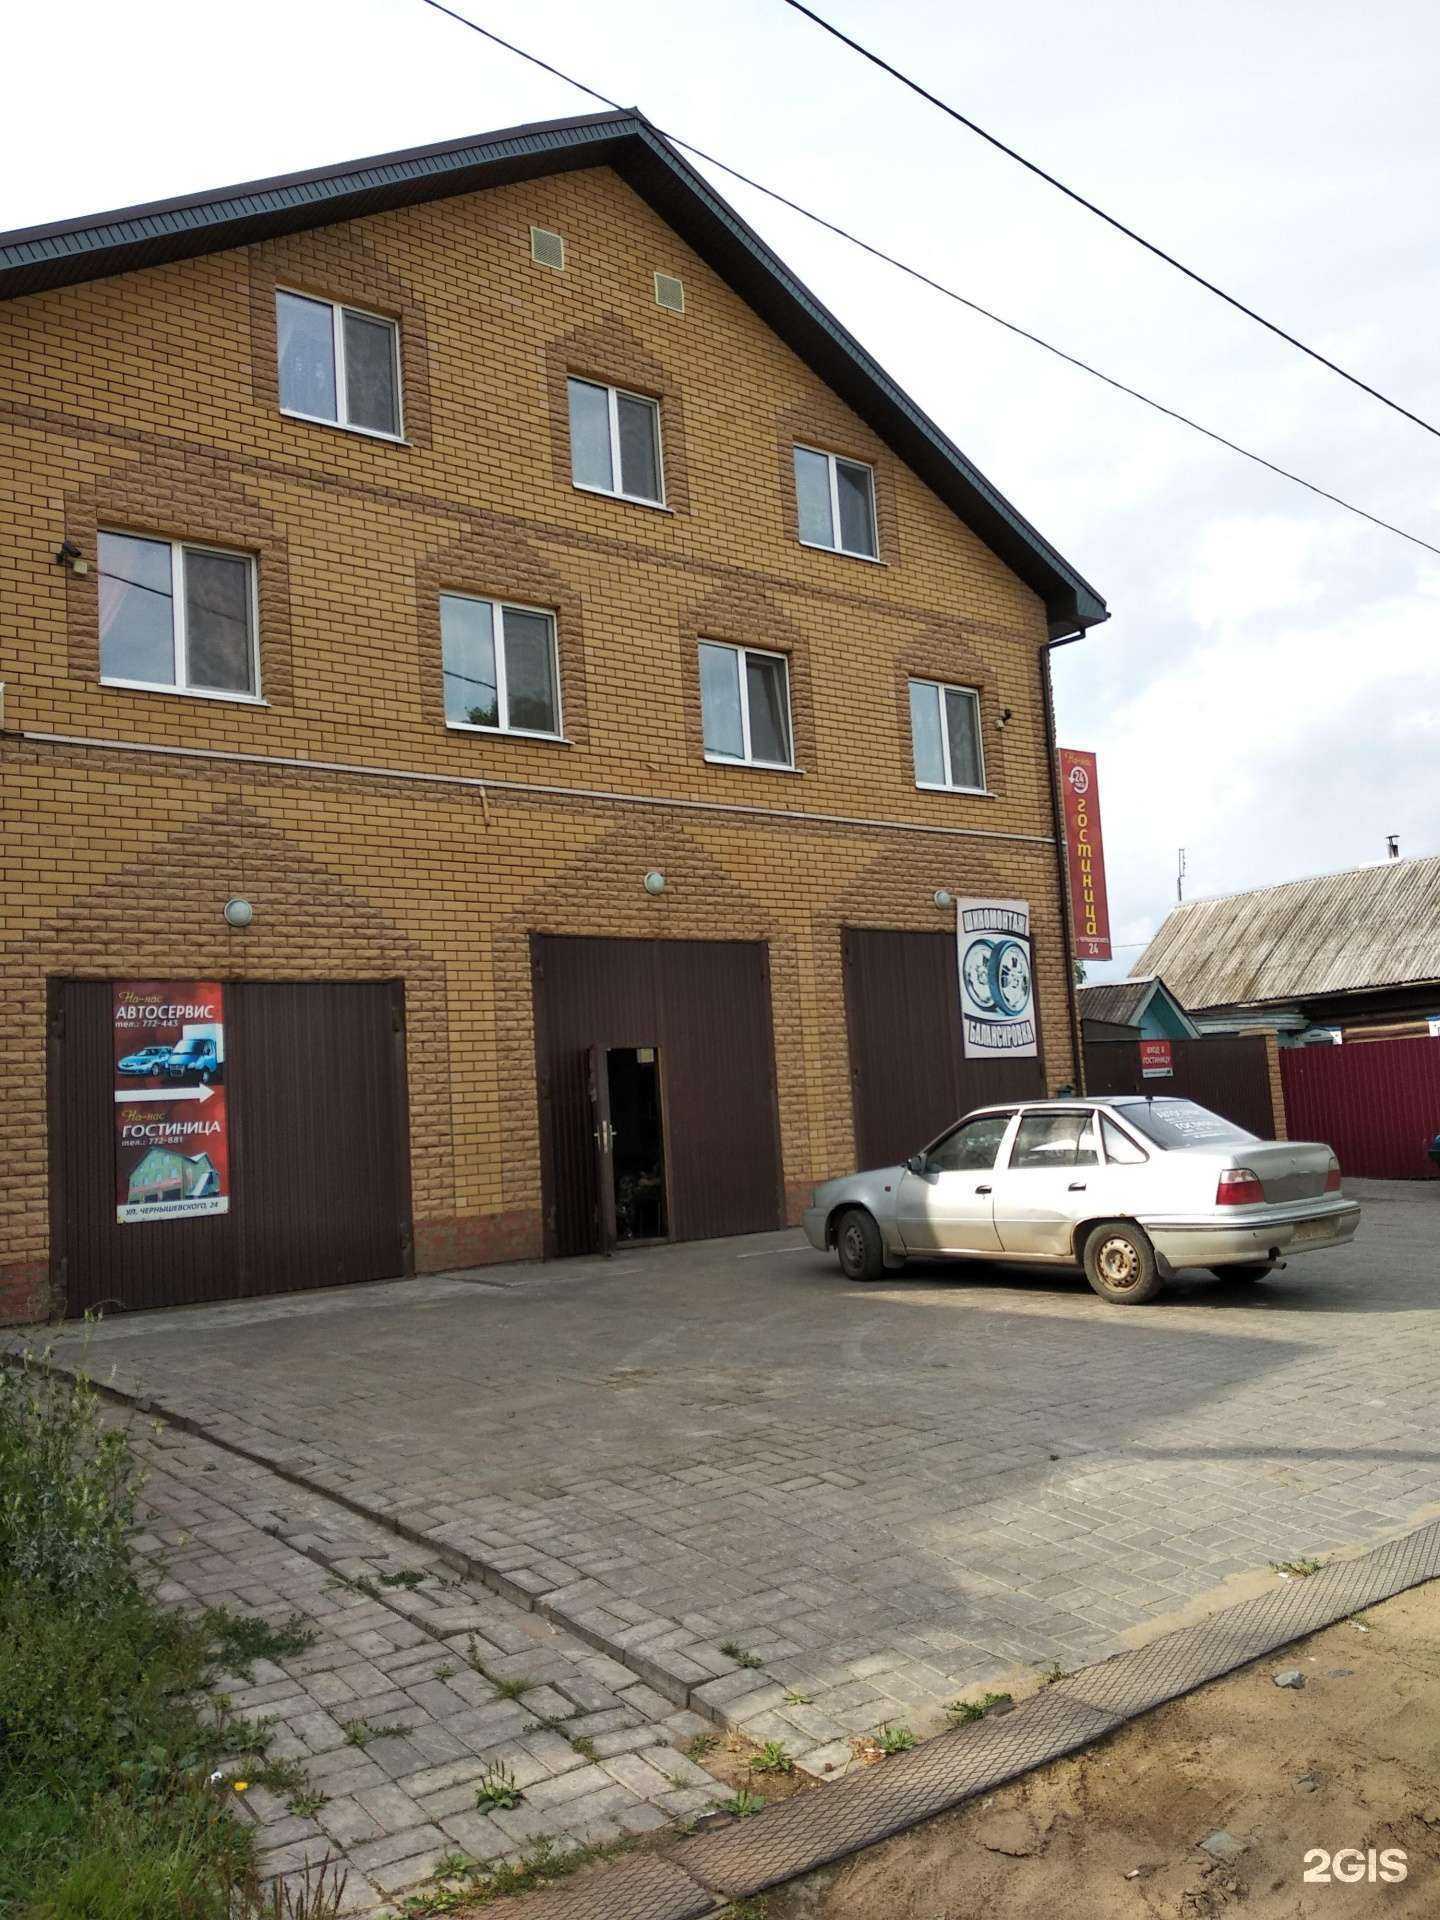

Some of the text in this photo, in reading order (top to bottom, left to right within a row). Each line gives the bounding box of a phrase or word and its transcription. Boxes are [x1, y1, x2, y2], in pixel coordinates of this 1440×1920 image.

[962, 908, 1027, 936] ШИНОМОНТАЖ
[1088, 943, 1099, 954] 24
[115, 1004, 215, 1019] АВТОСЕРВИС
[142, 1020, 179, 1028] 772-443
[968, 1020, 1035, 1048] БАЛАНСИРОВКА
[122, 1121, 221, 1138] ГОСТИНИЦА
[148, 1136, 183, 1145] 772-881
